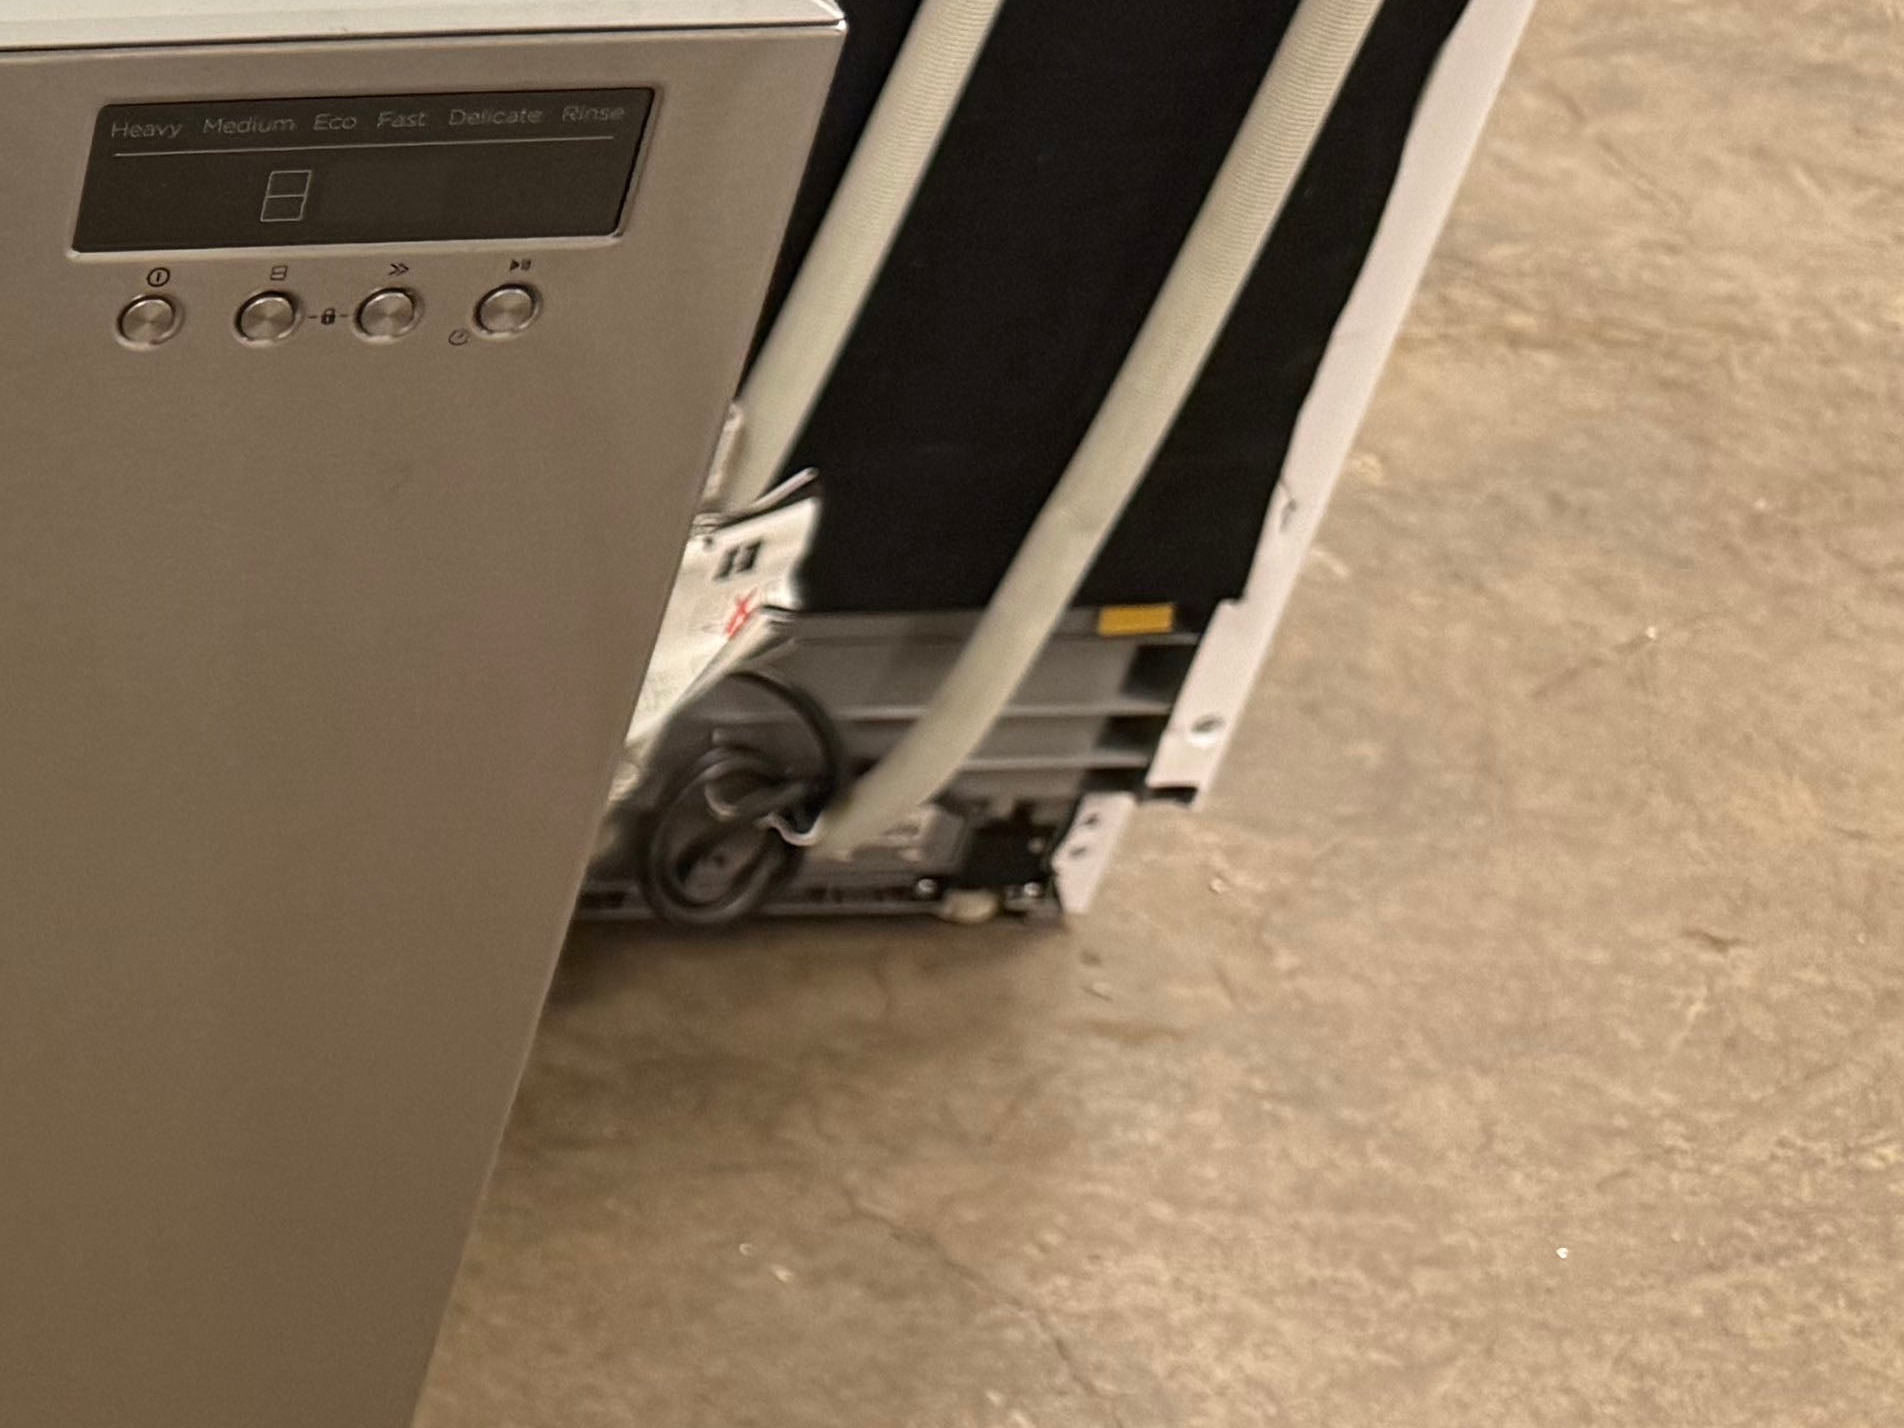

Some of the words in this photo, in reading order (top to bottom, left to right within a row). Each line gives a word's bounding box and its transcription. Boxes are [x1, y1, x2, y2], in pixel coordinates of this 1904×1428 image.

[111, 120, 182, 140] Heavy
[202, 116, 297, 135] Medium
[313, 112, 358, 131] Eco
[377, 111, 427, 129] Fast
[448, 105, 543, 127] Delicate
[561, 104, 626, 125] Rinse
